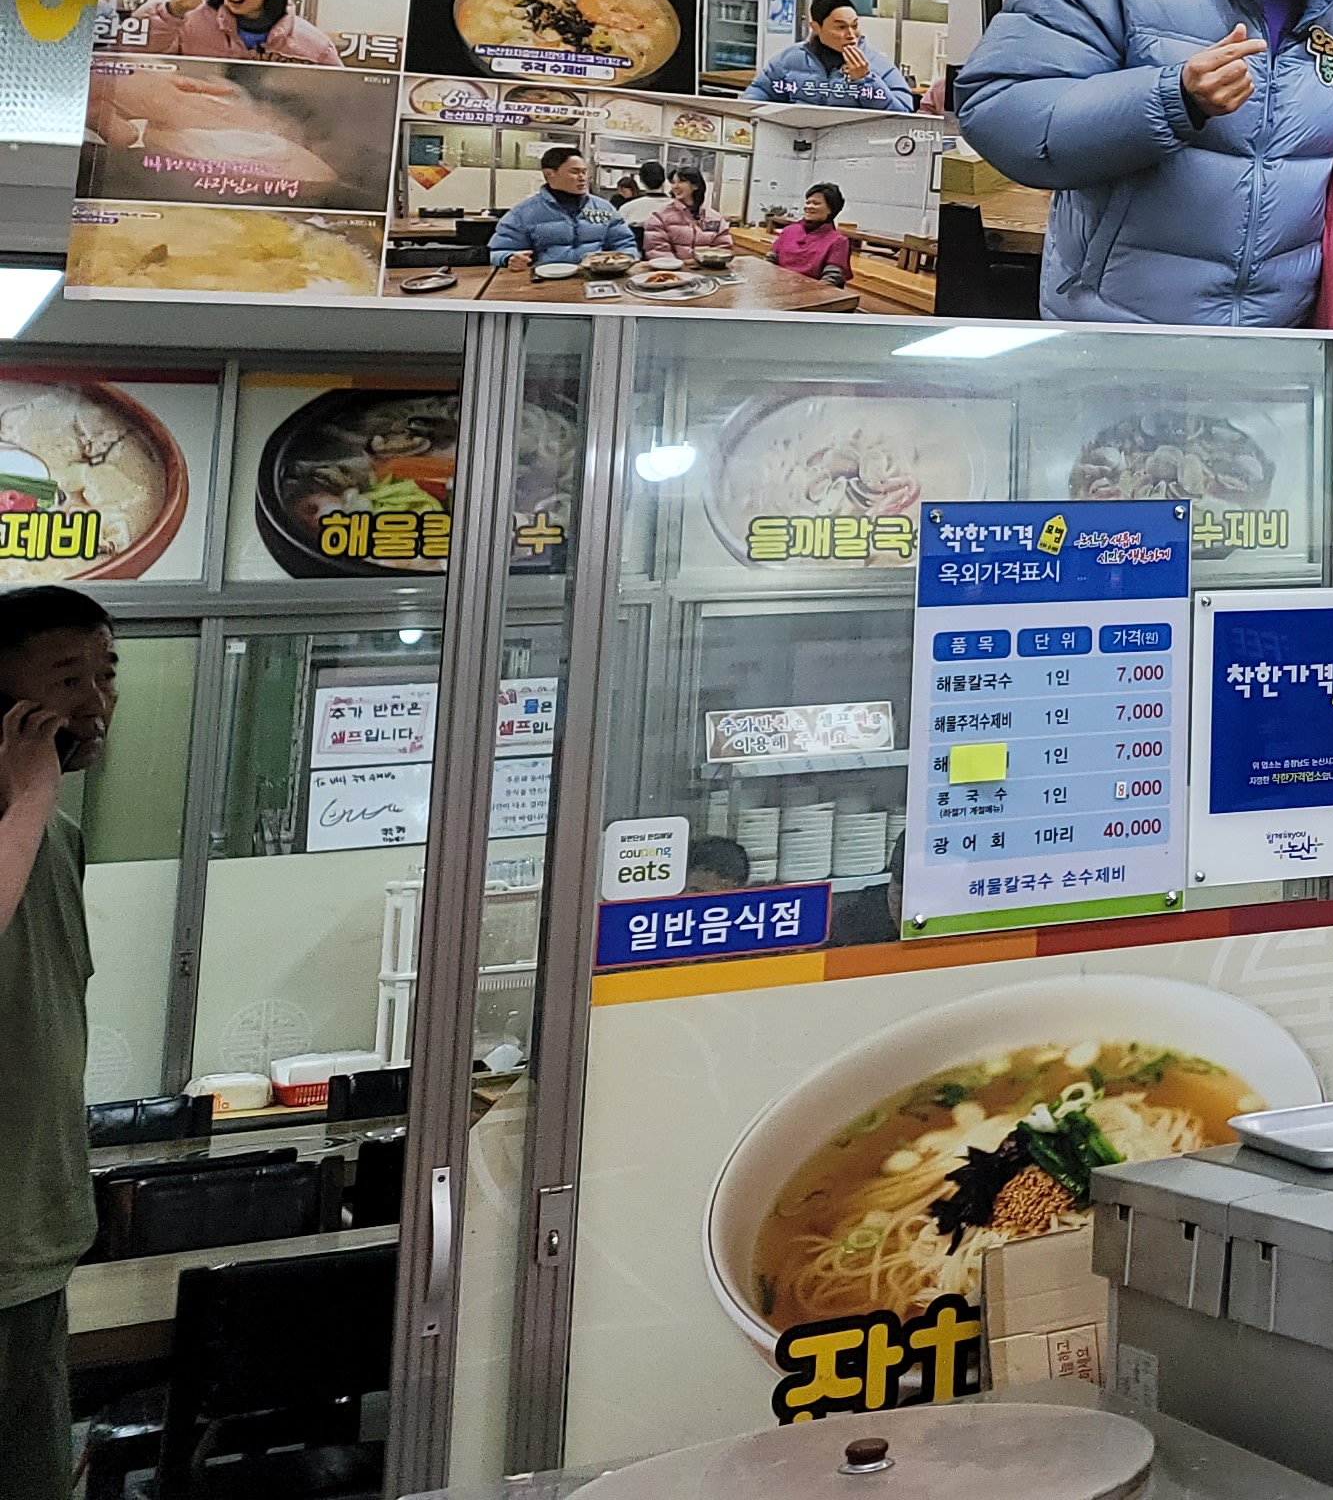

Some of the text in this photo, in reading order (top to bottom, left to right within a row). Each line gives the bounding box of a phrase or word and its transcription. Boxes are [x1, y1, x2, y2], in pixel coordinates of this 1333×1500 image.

[339, 33, 398, 63] 가득
[550, 63, 587, 77] 수제비
[772, 80, 798, 95] 진짜
[0, 510, 98, 560] 제비
[748, 514, 918, 562] 들깨칼국
[939, 522, 1033, 554] 착한가격
[937, 560, 1061, 586] 옥외가격표시
[936, 664, 1164, 692] 해물칼국수 1인 7,000
[1227, 662, 1333, 698] 착한가격
[329, 702, 422, 720] 추가 반찬은
[934, 702, 1163, 733] 해물주걱수제비 1인 7,000
[1044, 740, 1163, 764] 1인 7,000
[1043, 786, 1068, 804] 1인
[1116, 779, 1162, 799] 8,000
[1034, 825, 1074, 845] 1마리
[1103, 818, 1162, 838] 40,000
[618, 860, 671, 884] eats
[968, 864, 1127, 897] 해물칼국수 손수제비
[628, 898, 801, 952] 일반음식점
